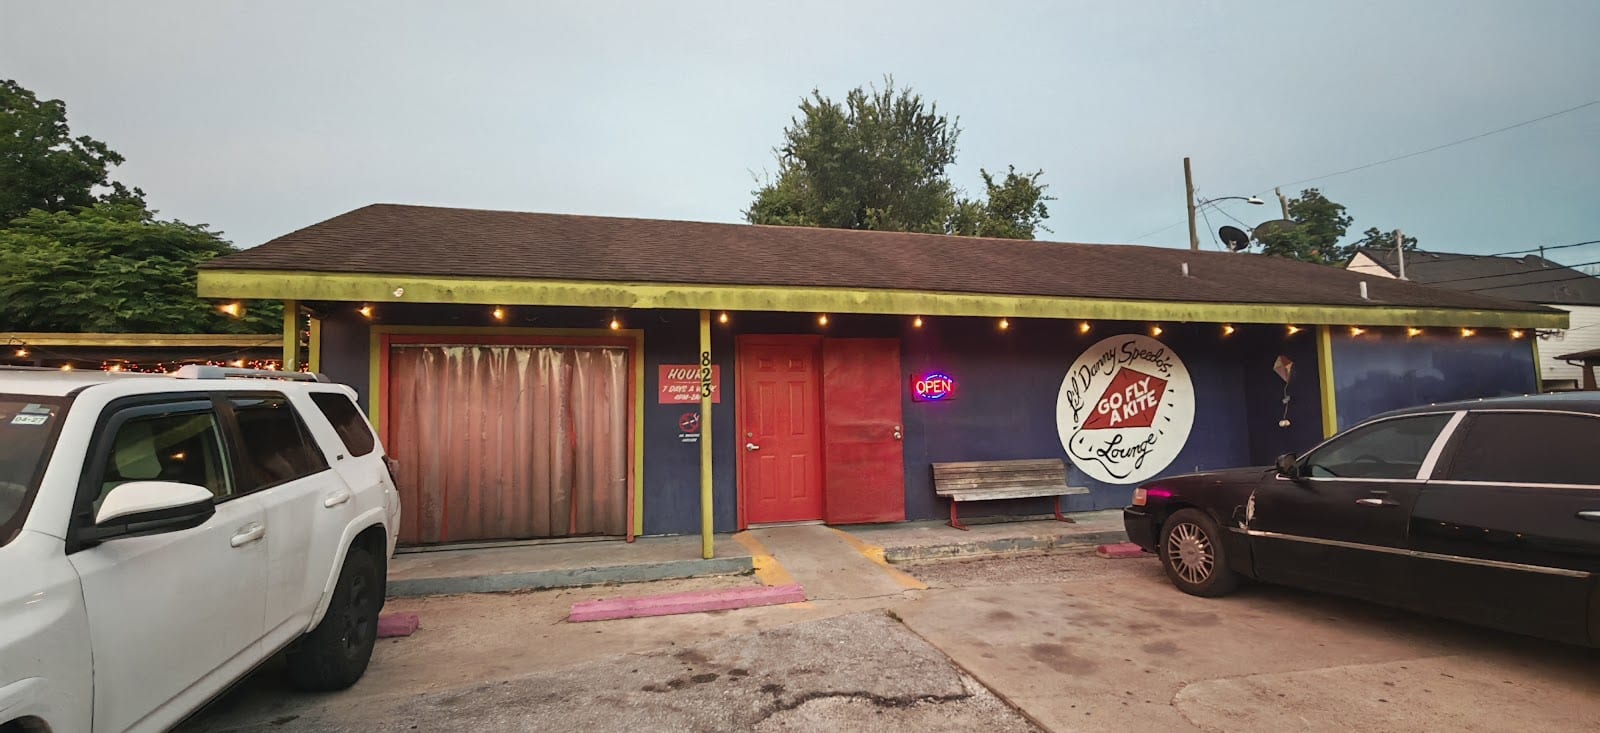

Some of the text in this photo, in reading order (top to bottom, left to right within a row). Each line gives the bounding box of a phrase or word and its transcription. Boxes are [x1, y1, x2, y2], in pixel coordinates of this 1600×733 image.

[702, 352, 710, 397] 823
[1078, 346, 1117, 393] Danny
[1118, 341, 1173, 373] Speedo's
[916, 380, 951, 393] OPEN
[1098, 377, 1150, 414] GO FLY
[1110, 390, 1157, 426] A KITE
[1096, 434, 1157, 469] Lounge
